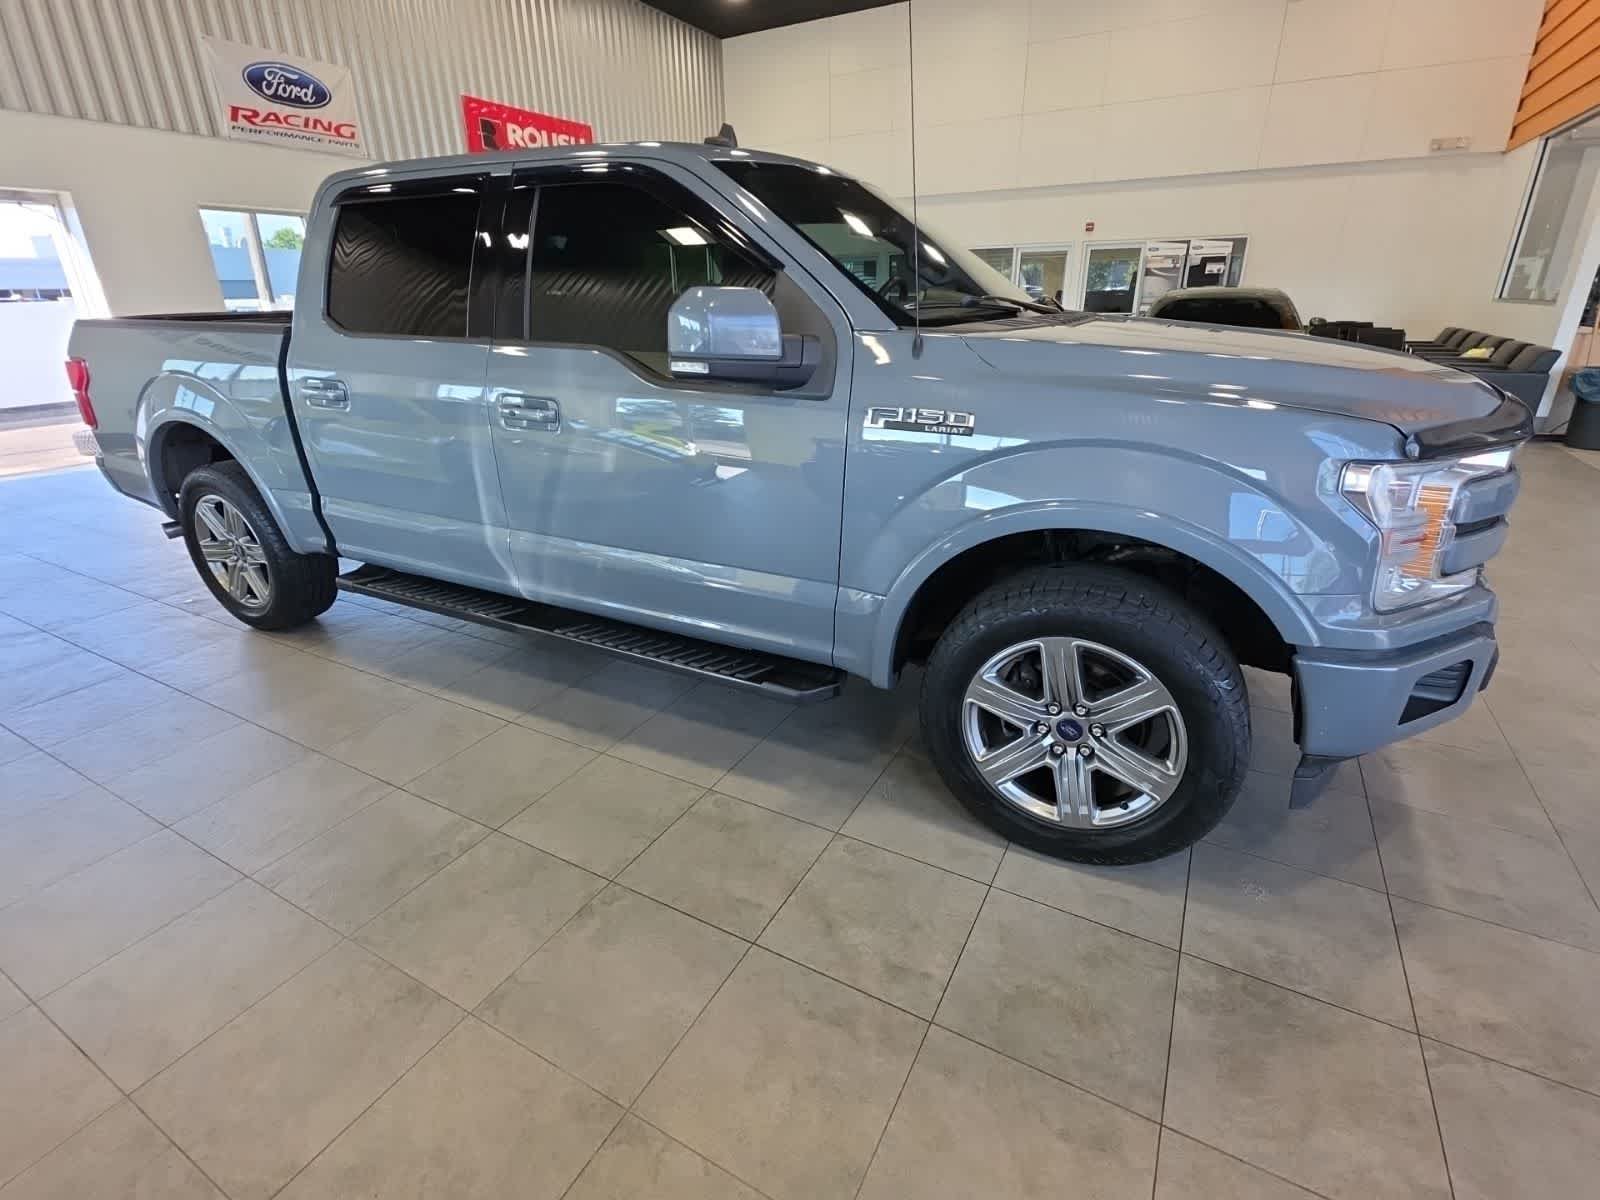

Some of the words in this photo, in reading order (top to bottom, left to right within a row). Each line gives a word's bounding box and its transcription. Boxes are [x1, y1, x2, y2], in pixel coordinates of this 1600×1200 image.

[262, 67, 316, 103] Ford
[230, 105, 357, 140] RACING
[231, 125, 322, 143] PERFORMANCE
[924, 424, 966, 434] LARIAT
